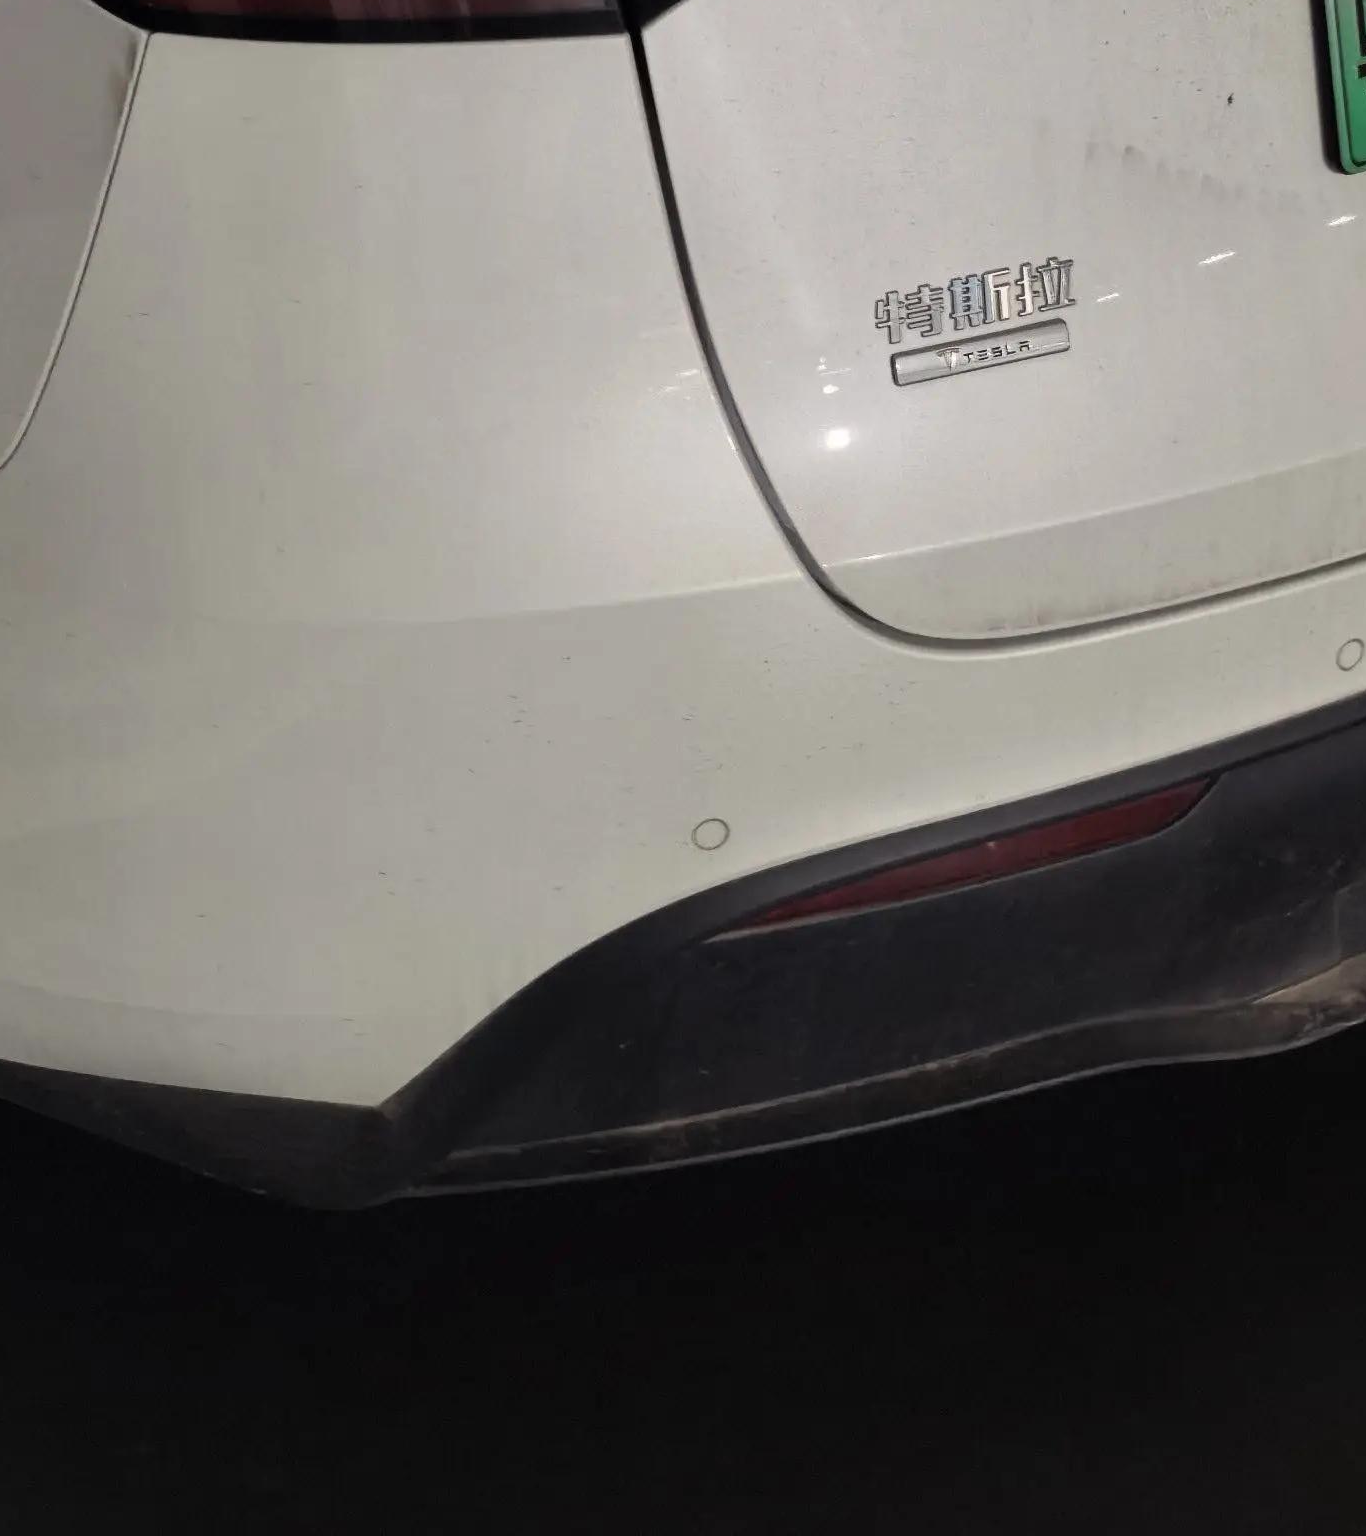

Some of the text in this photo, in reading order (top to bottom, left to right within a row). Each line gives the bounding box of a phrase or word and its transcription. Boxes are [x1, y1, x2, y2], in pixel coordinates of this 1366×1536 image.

[874, 257, 1076, 344] 特斯拉
[963, 340, 1031, 364] TESLA
